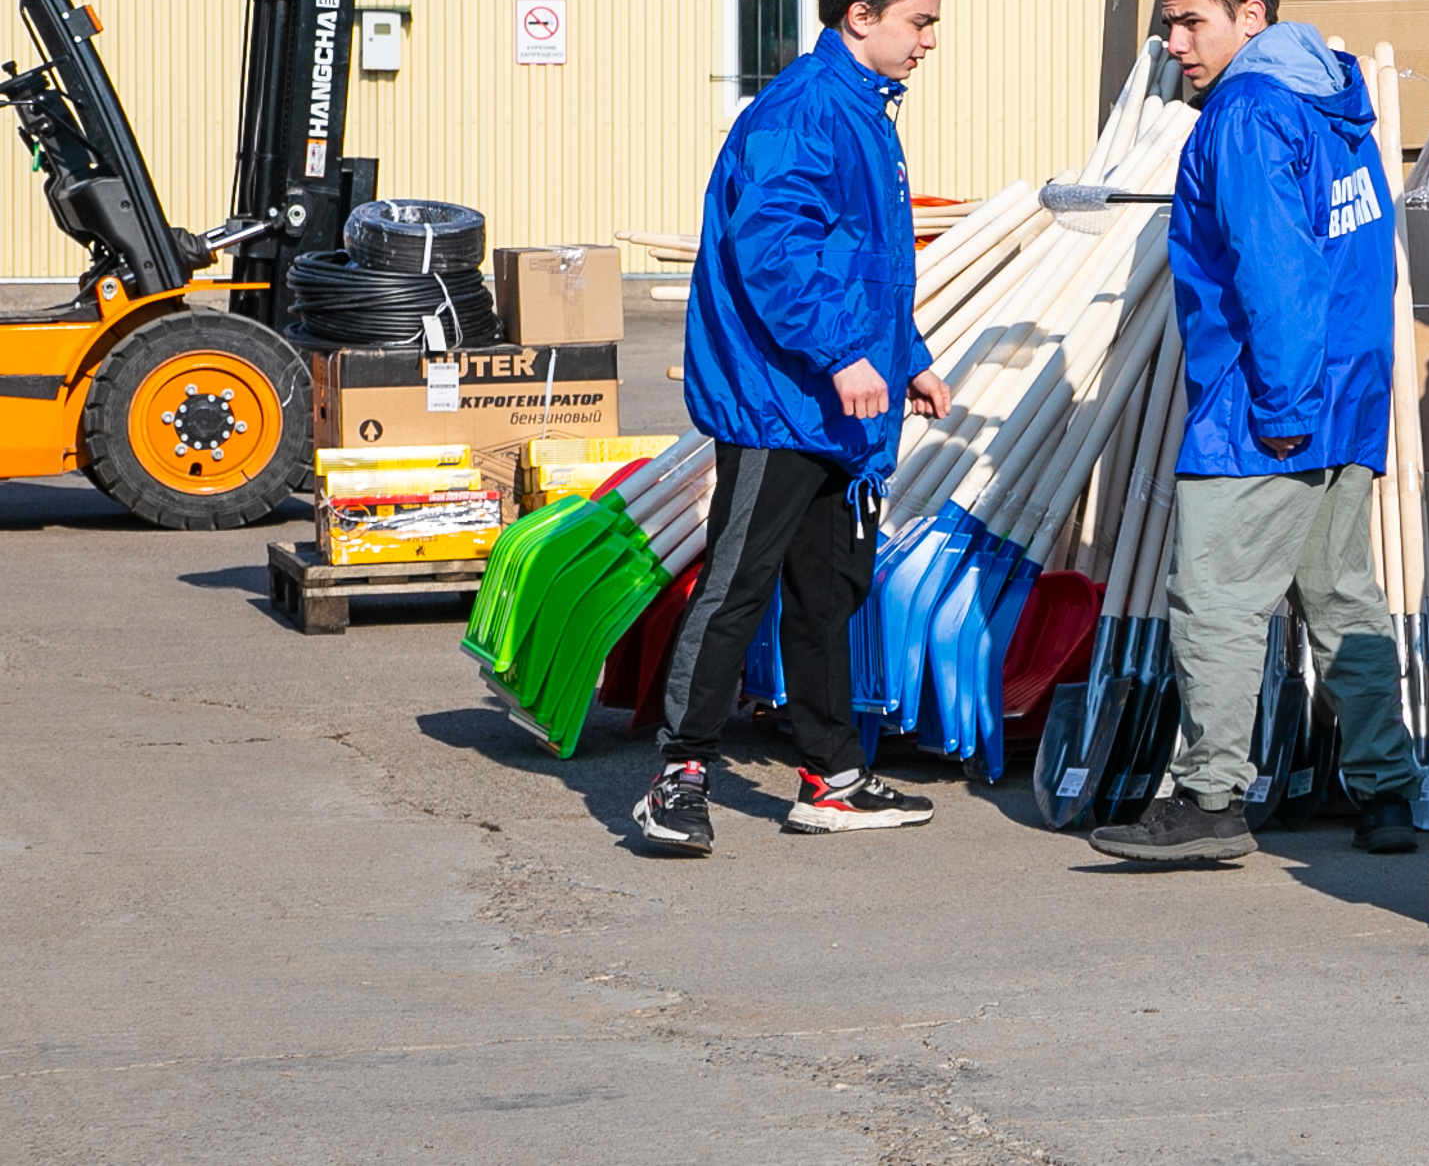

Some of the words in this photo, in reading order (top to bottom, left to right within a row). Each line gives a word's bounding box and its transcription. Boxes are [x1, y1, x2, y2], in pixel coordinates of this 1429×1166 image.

[308, 10, 338, 138] HANGCHA
[458, 393, 604, 410] КТРОГЕНЕРАТОР
[509, 410, 603, 426] бензиновый
